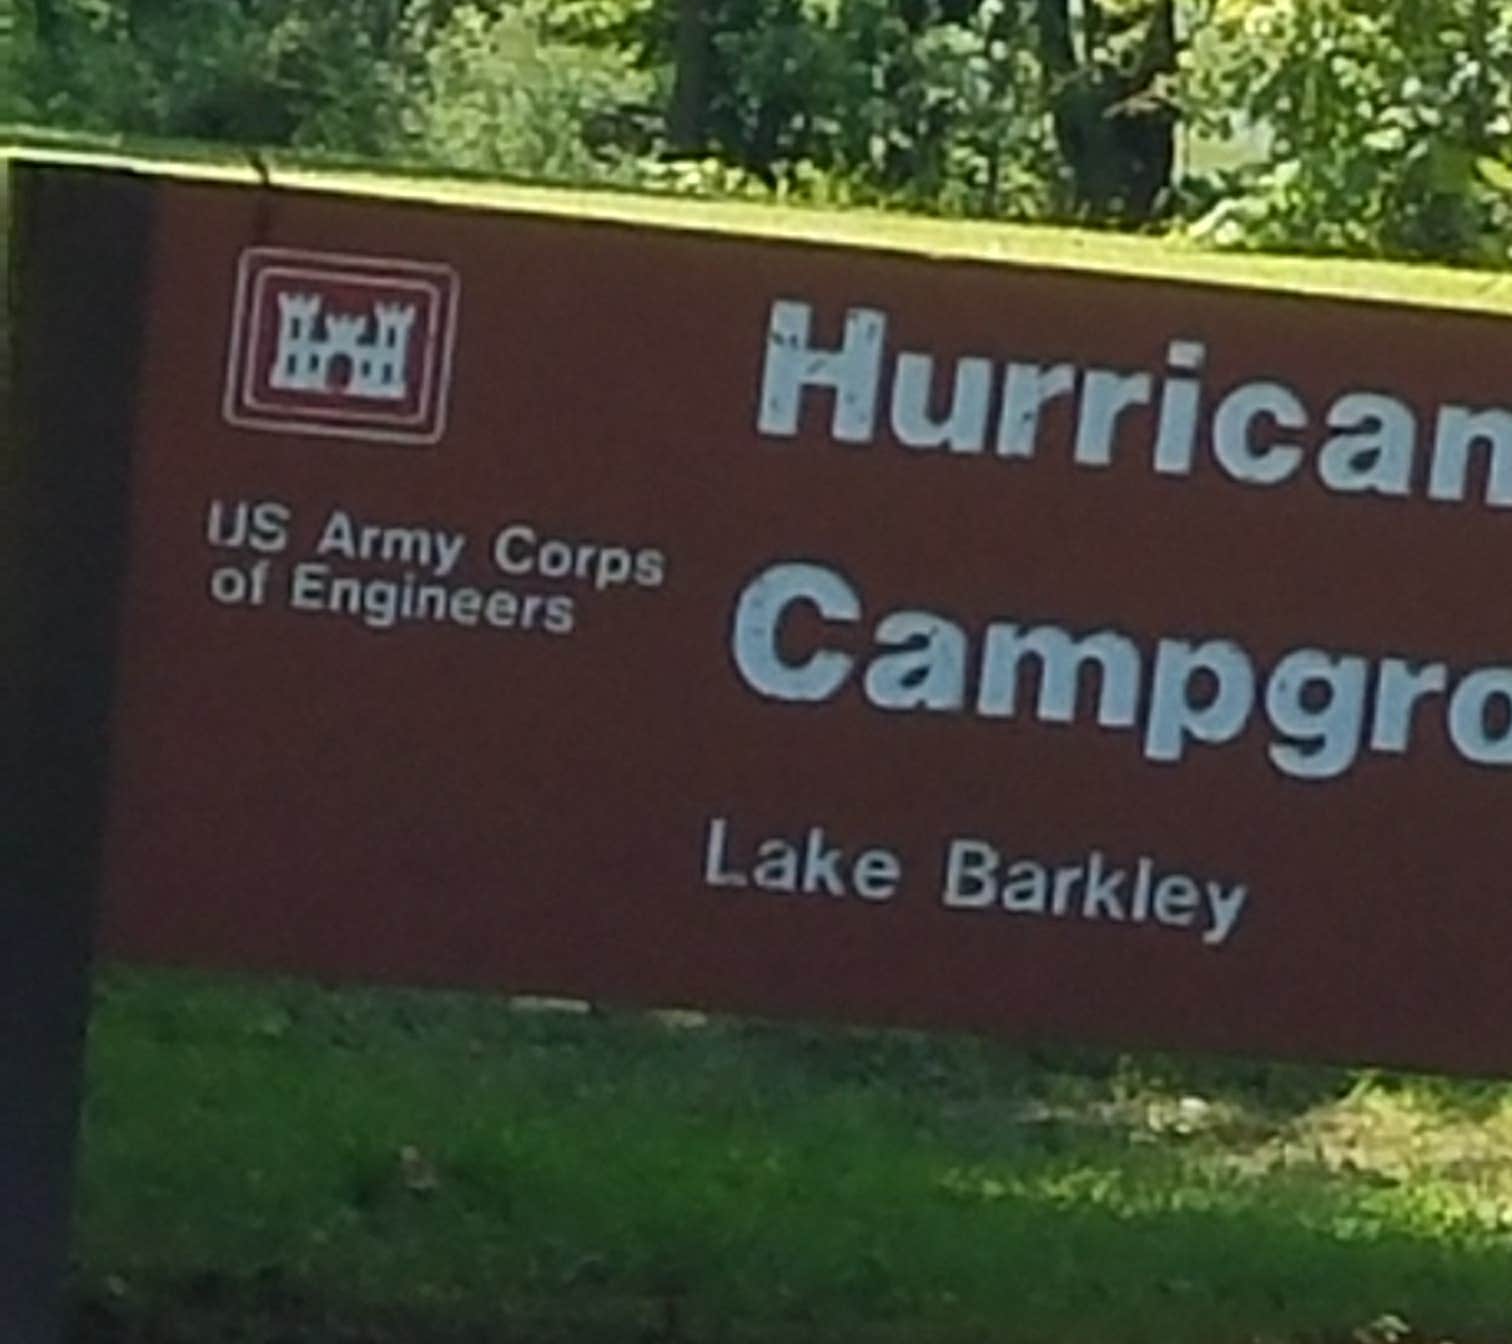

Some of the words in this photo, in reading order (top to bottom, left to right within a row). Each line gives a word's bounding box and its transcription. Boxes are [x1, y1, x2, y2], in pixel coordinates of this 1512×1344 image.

[207, 501, 290, 552] US
[318, 512, 464, 577] Army
[495, 526, 665, 588] Corps
[211, 561, 268, 603] of
[291, 566, 575, 634] Engineers
[703, 819, 900, 902] Lake
[943, 840, 1248, 944] Barkley
